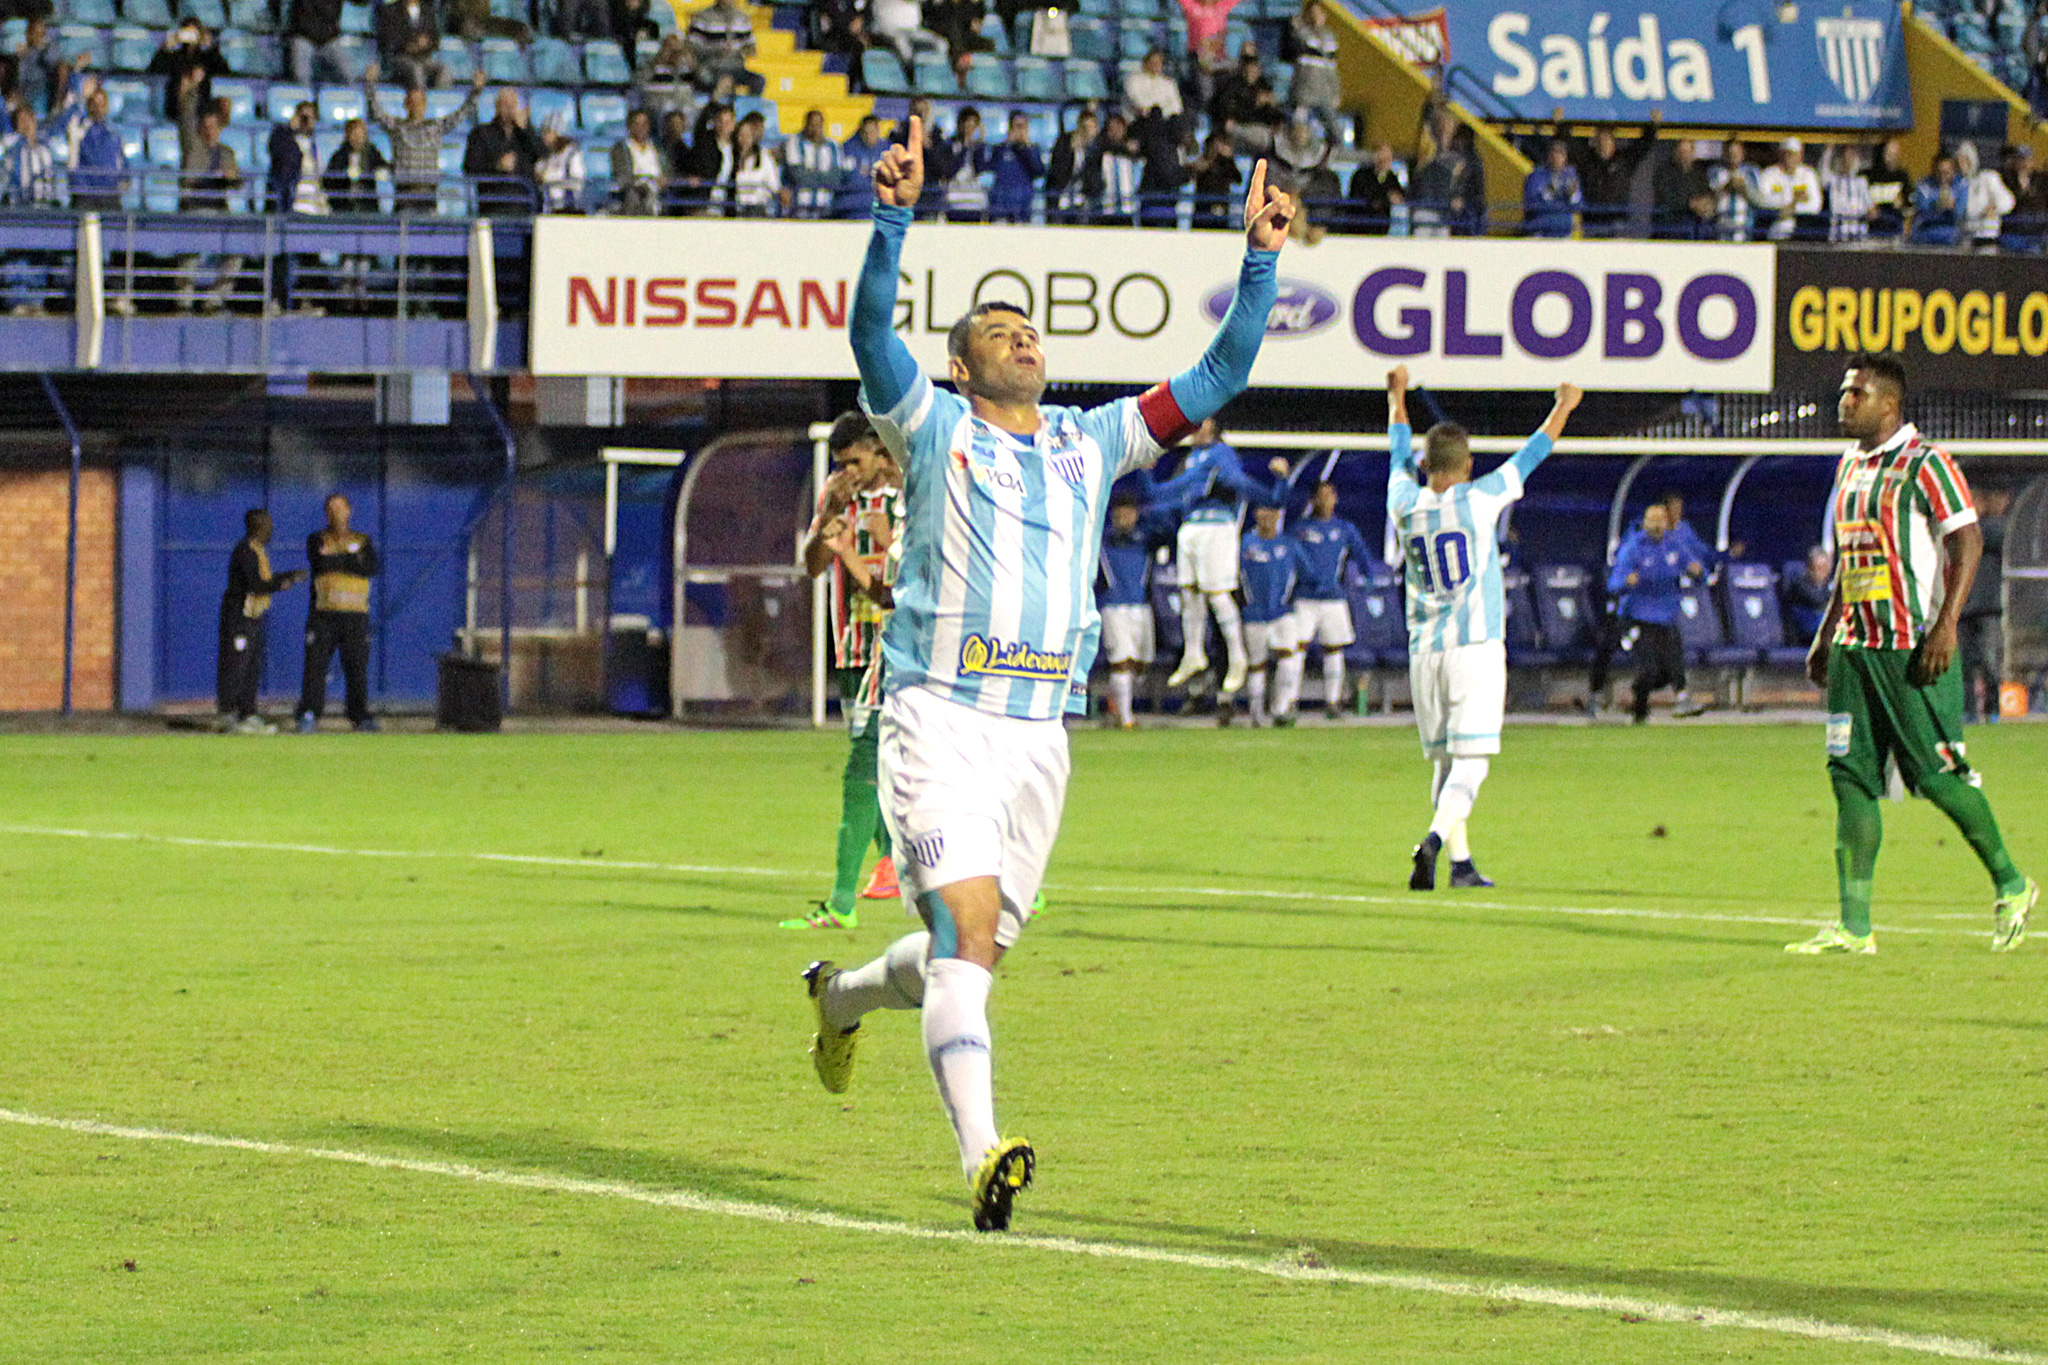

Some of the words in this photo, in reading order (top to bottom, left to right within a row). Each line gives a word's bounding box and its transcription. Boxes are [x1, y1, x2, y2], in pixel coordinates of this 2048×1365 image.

[1488, 12, 1714, 102] Saída
[1733, 24, 1772, 105] 1
[567, 276, 847, 329] NISSAN
[1353, 267, 1757, 360] GLOBO
[1408, 530, 1471, 594] 10
